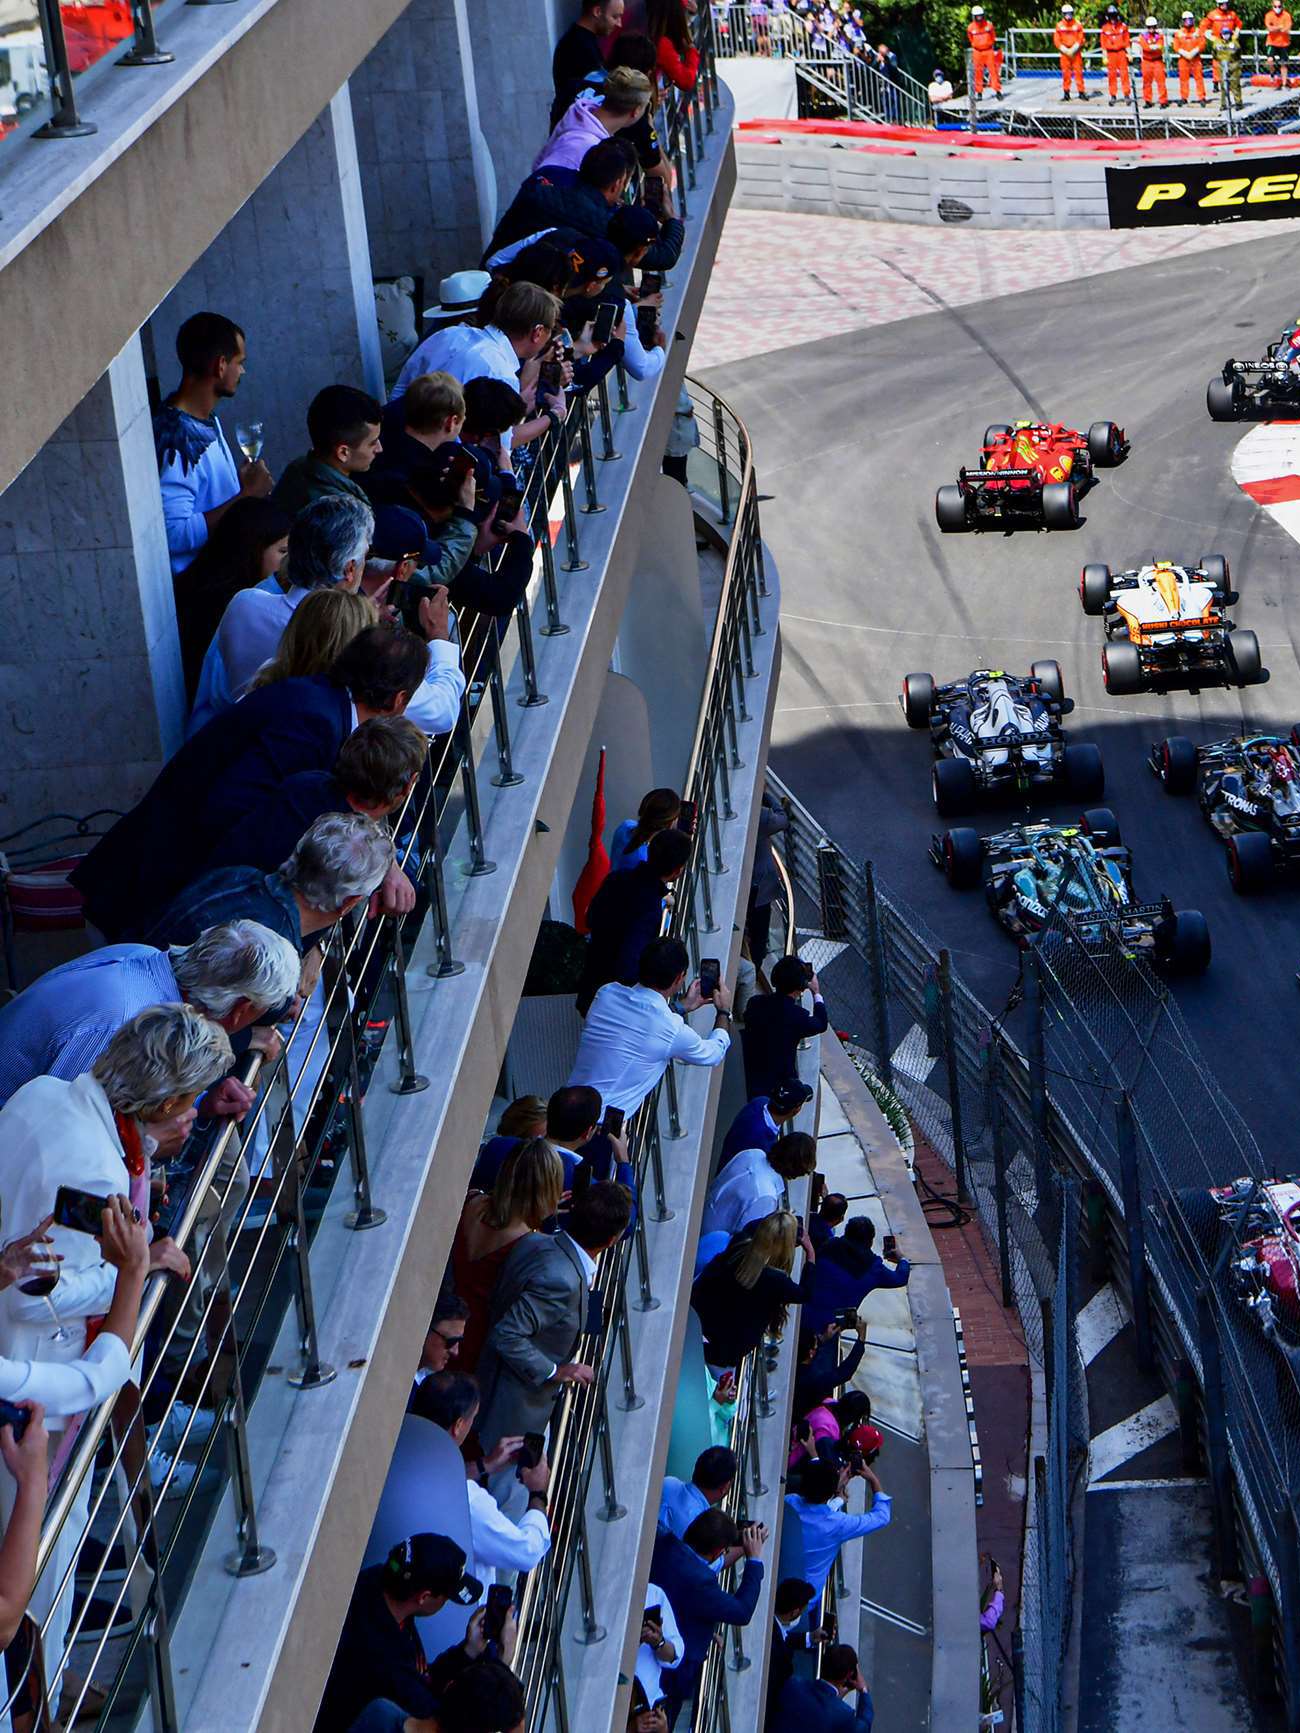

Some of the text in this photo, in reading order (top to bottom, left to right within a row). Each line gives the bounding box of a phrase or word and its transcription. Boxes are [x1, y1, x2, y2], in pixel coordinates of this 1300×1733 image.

[1136, 183, 1187, 210] P
[1244, 361, 1276, 370] INEOS
[981, 732, 1053, 746] HONDA
